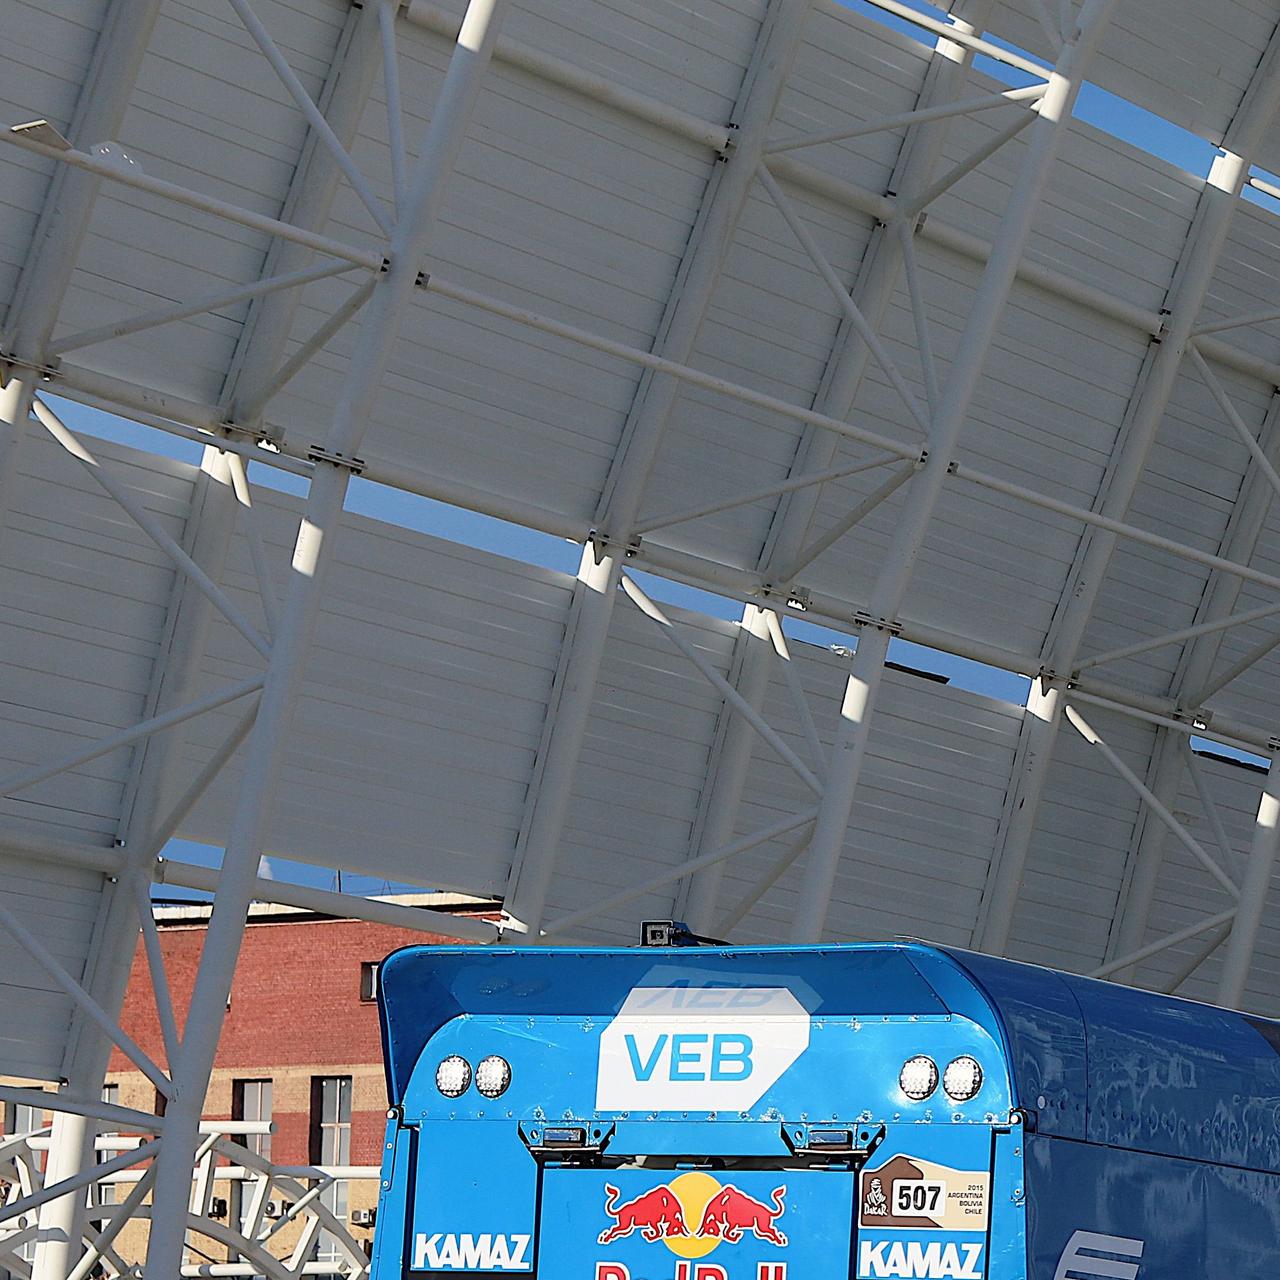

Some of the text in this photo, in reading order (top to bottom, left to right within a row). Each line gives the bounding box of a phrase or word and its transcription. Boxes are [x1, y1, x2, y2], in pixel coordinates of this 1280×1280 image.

[624, 1033, 754, 1082] VEB
[898, 1185, 941, 1211] 507
[947, 1192, 984, 1200] ARGENTINA
[967, 1184, 984, 1192] 2015
[413, 1233, 532, 1270] KAMAZ
[859, 1240, 984, 1280] KAMAZ
